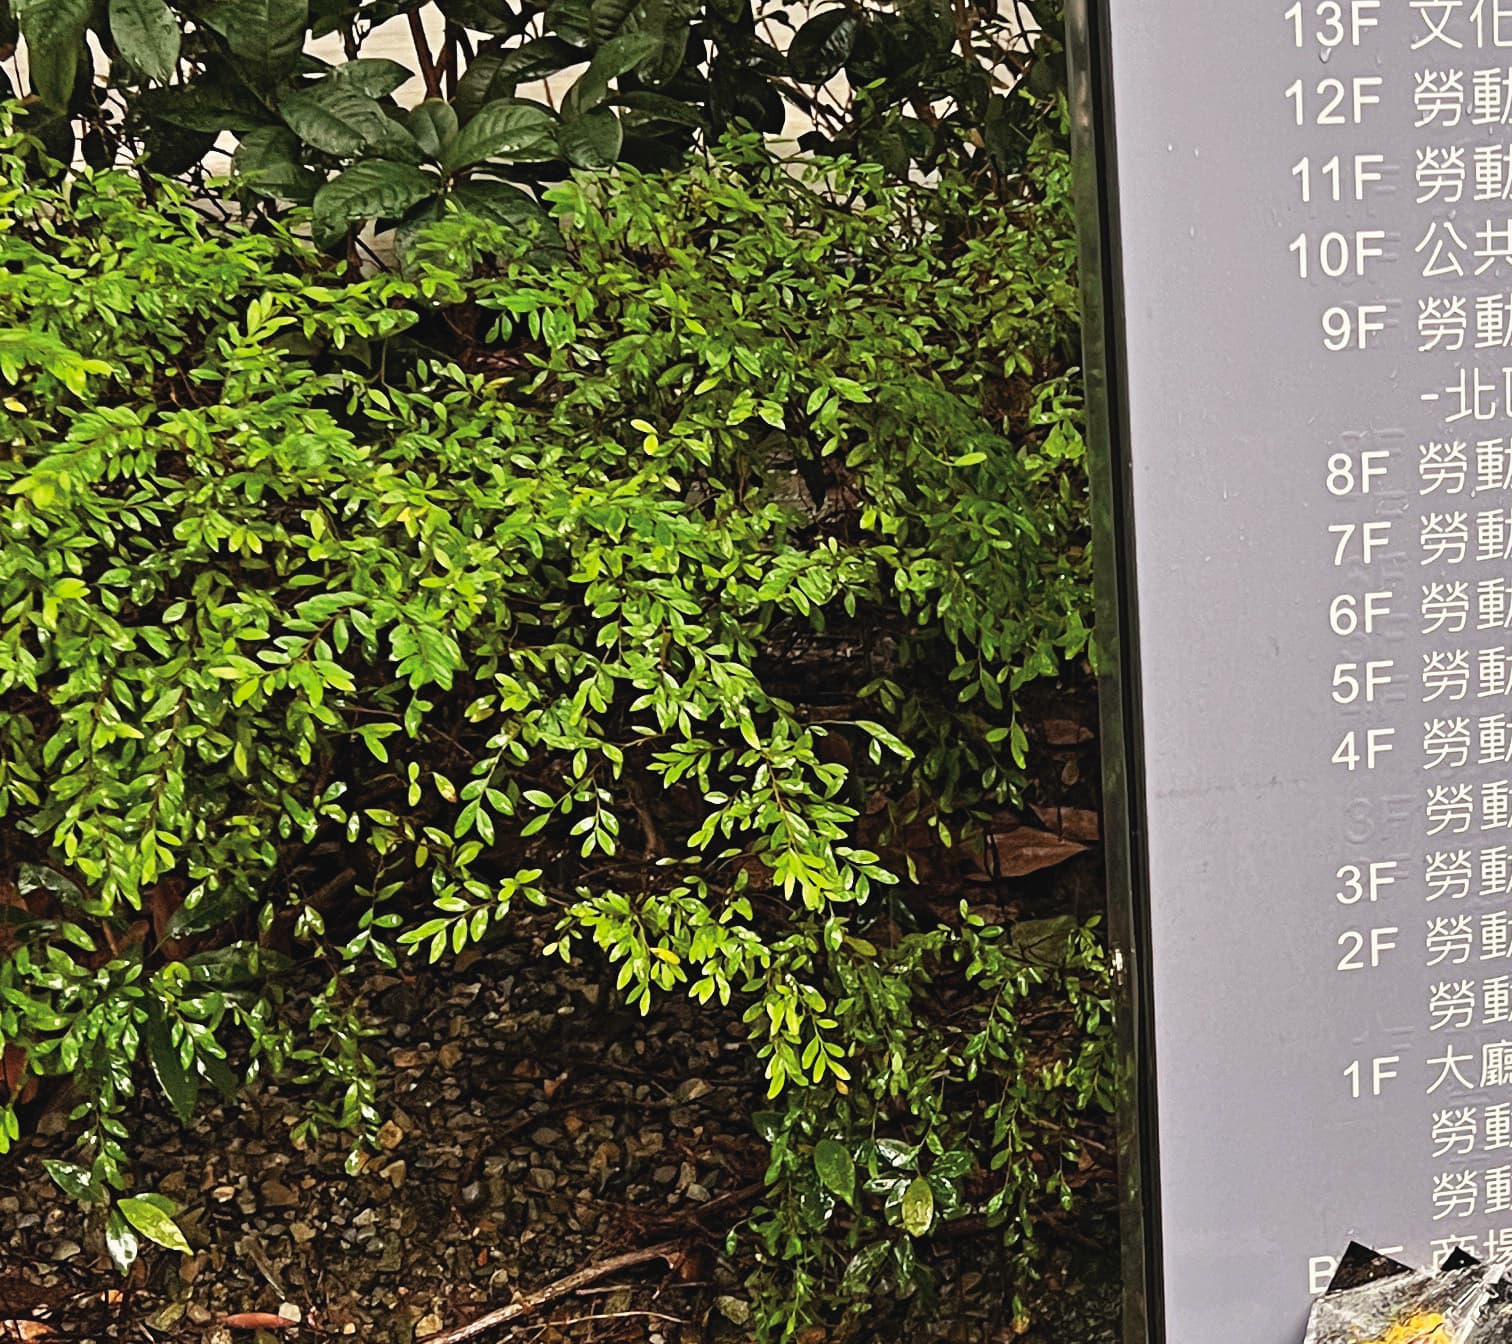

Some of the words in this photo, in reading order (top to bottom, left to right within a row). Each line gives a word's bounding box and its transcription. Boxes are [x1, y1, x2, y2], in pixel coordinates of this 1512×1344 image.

[1285, 0, 1380, 49] 13F
[1285, 77, 1382, 125] 12F
[1293, 155, 1383, 201] 11F
[1290, 231, 1385, 277] 10F
[1323, 306, 1386, 350] 9F
[1327, 450, 1389, 495] 8F
[1329, 522, 1391, 565] 7F
[1330, 592, 1392, 635] 6F
[1332, 660, 1393, 703] 5F
[1332, 728, 1395, 770] 4F
[1337, 862, 1397, 903] 3F
[1337, 927, 1398, 970] 2F
[1344, 1056, 1399, 1097] 1F
